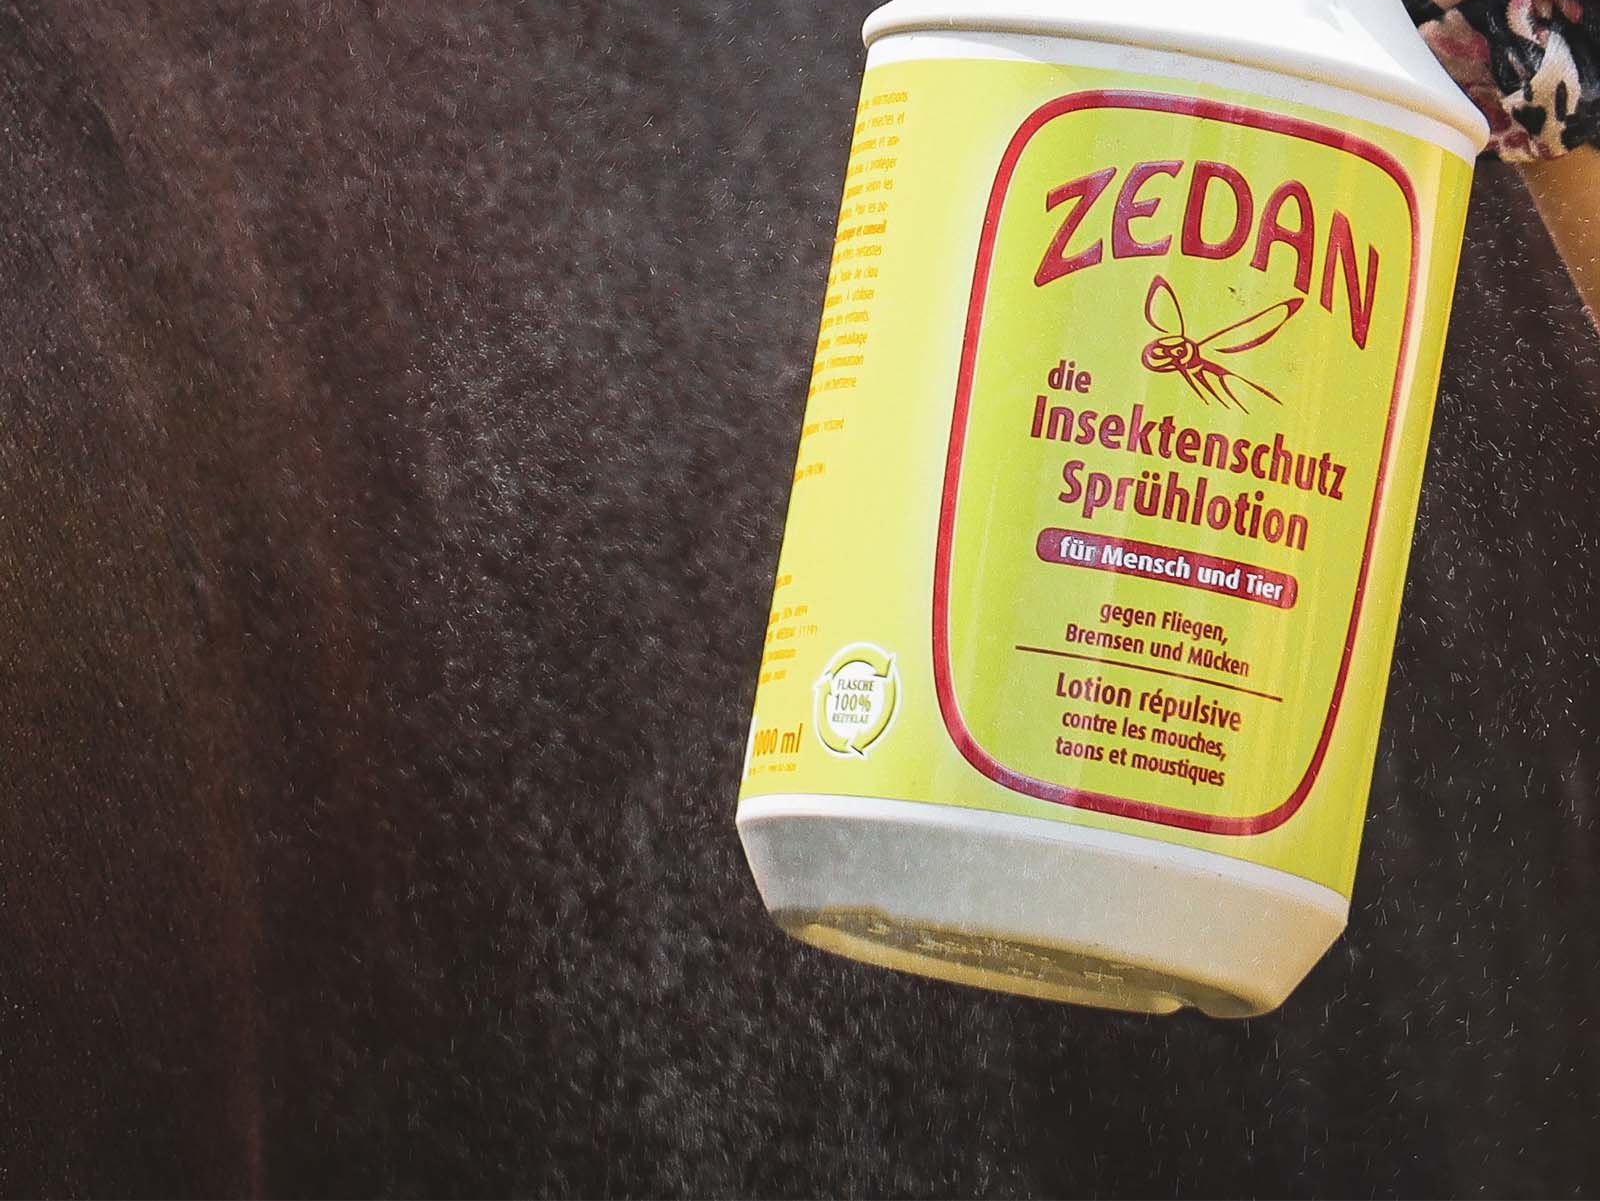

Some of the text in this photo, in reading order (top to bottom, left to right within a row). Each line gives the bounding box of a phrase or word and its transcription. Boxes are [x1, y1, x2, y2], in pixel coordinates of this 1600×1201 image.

[1034, 159, 1379, 350] ZEDAN
[1047, 359, 1092, 393] die
[1030, 395, 1348, 500] Insektenschutz
[1058, 460, 1308, 551] Sprühlotion
[1060, 537, 1284, 601] für Mensch und Tier
[1065, 624, 1249, 677] Bremsen und Mücken
[1100, 604, 1228, 645] gegen Fliegen,
[835, 694, 871, 712] 100%
[1056, 672, 1242, 731] Lotion répulsive
[780, 722, 803, 753] ml
[1056, 736, 1225, 787] taons et moustiques
[1062, 712, 1227, 760] contre les mouches,
